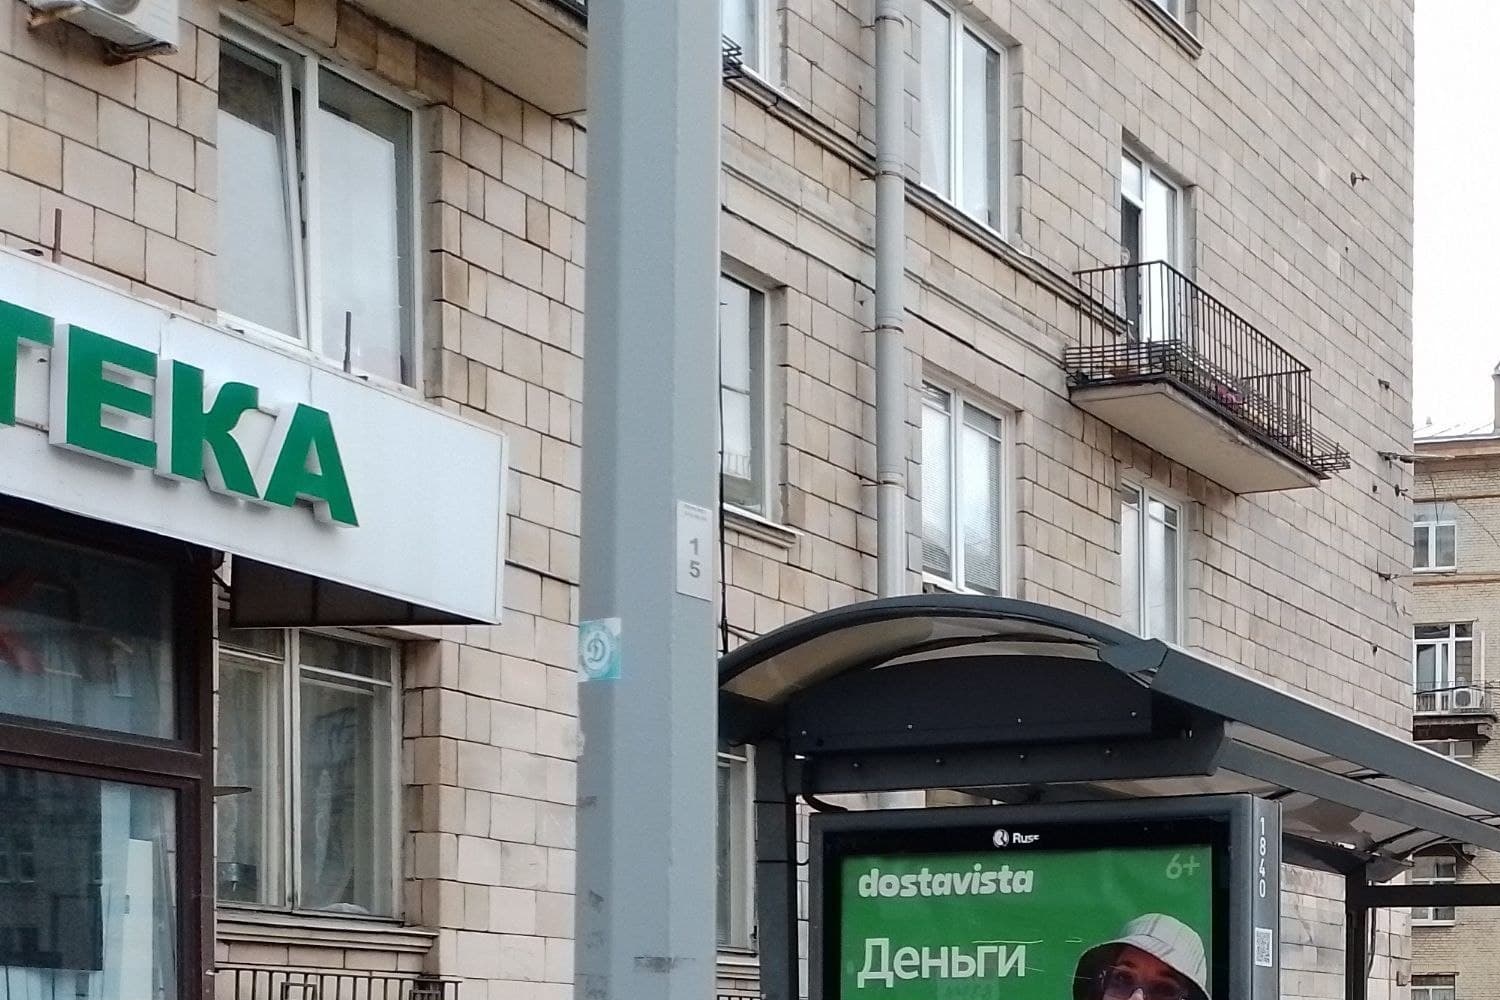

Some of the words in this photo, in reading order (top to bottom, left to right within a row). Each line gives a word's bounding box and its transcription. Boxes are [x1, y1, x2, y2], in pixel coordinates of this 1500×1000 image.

[1165, 853, 1201, 880] 6+
[1258, 816, 1267, 898] 1840
[858, 864, 1034, 898] dostavista
[857, 938, 1026, 988] Деньги
